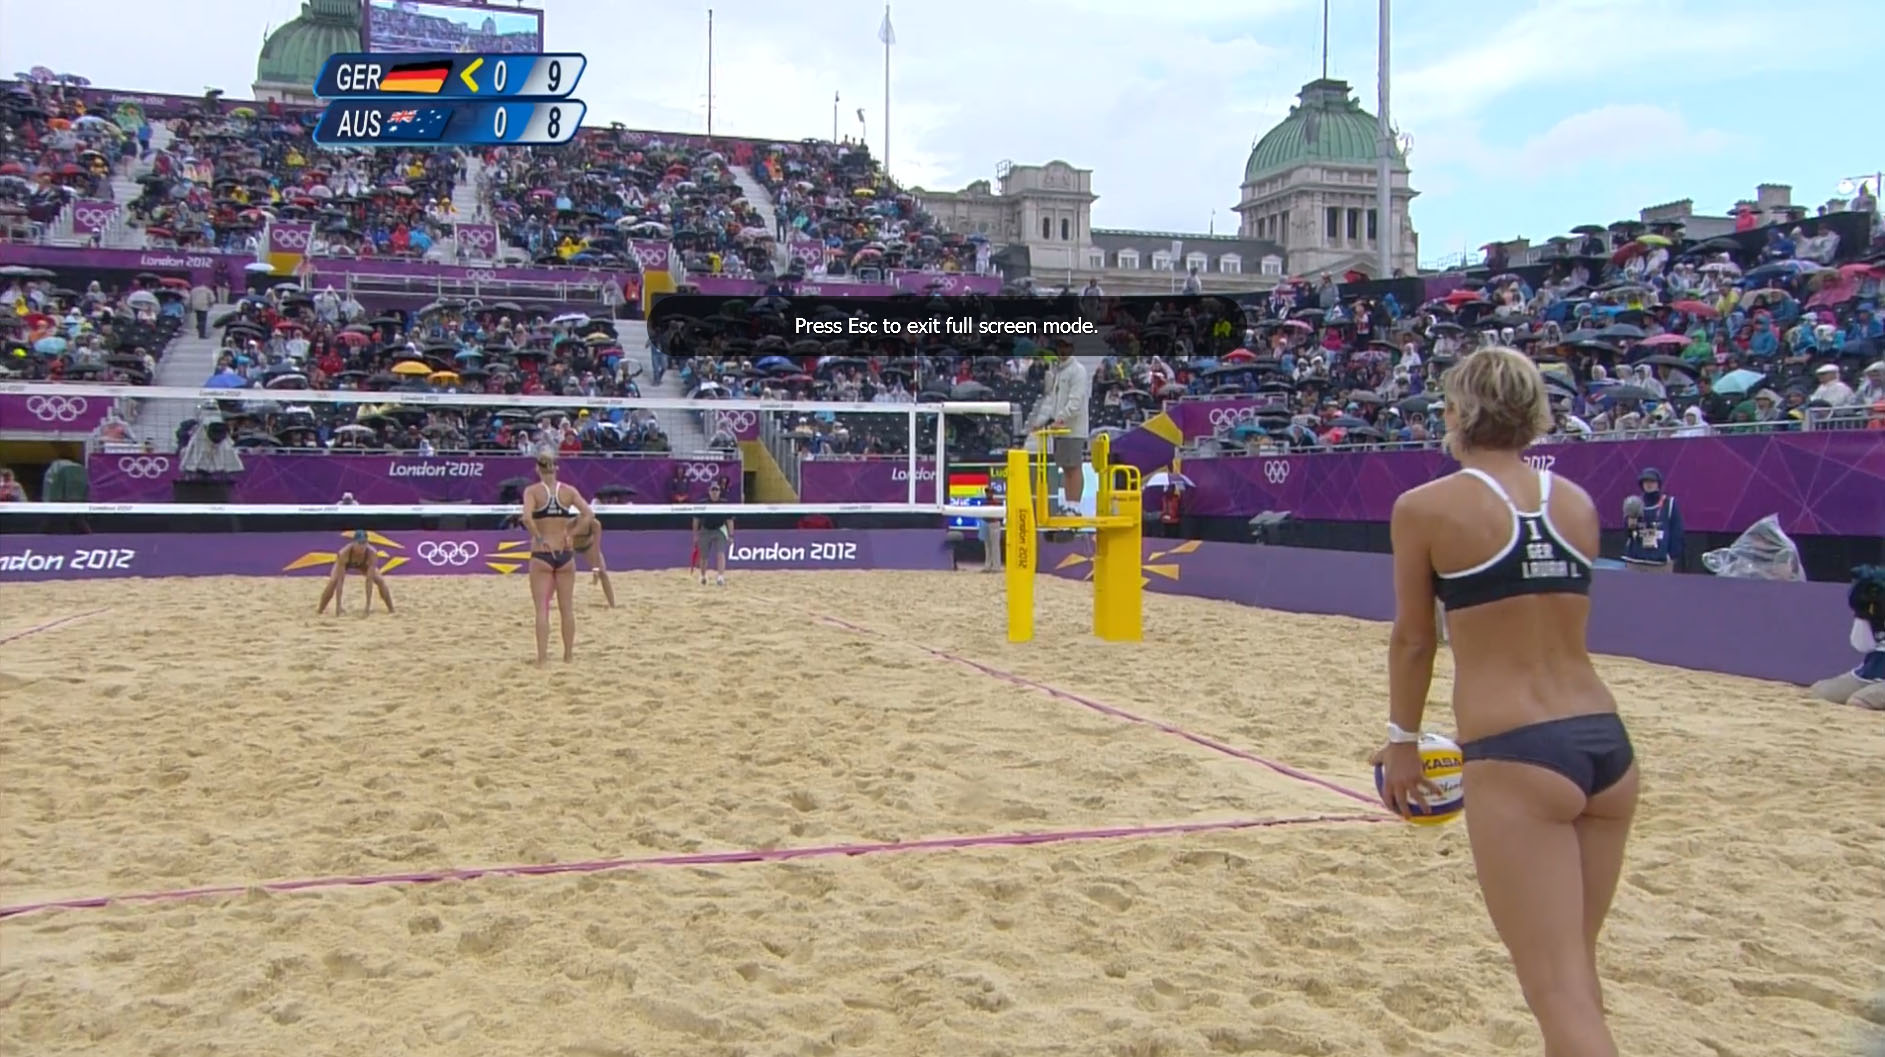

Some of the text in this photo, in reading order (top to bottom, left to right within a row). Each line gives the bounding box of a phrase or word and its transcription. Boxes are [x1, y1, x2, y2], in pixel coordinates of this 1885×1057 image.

[140, 254, 214, 268] London 2012
[389, 461, 484, 476] London 2012
[1526, 519, 1542, 541] 1
[70, 548, 136, 570] 2012
[728, 542, 857, 561] London 2012
